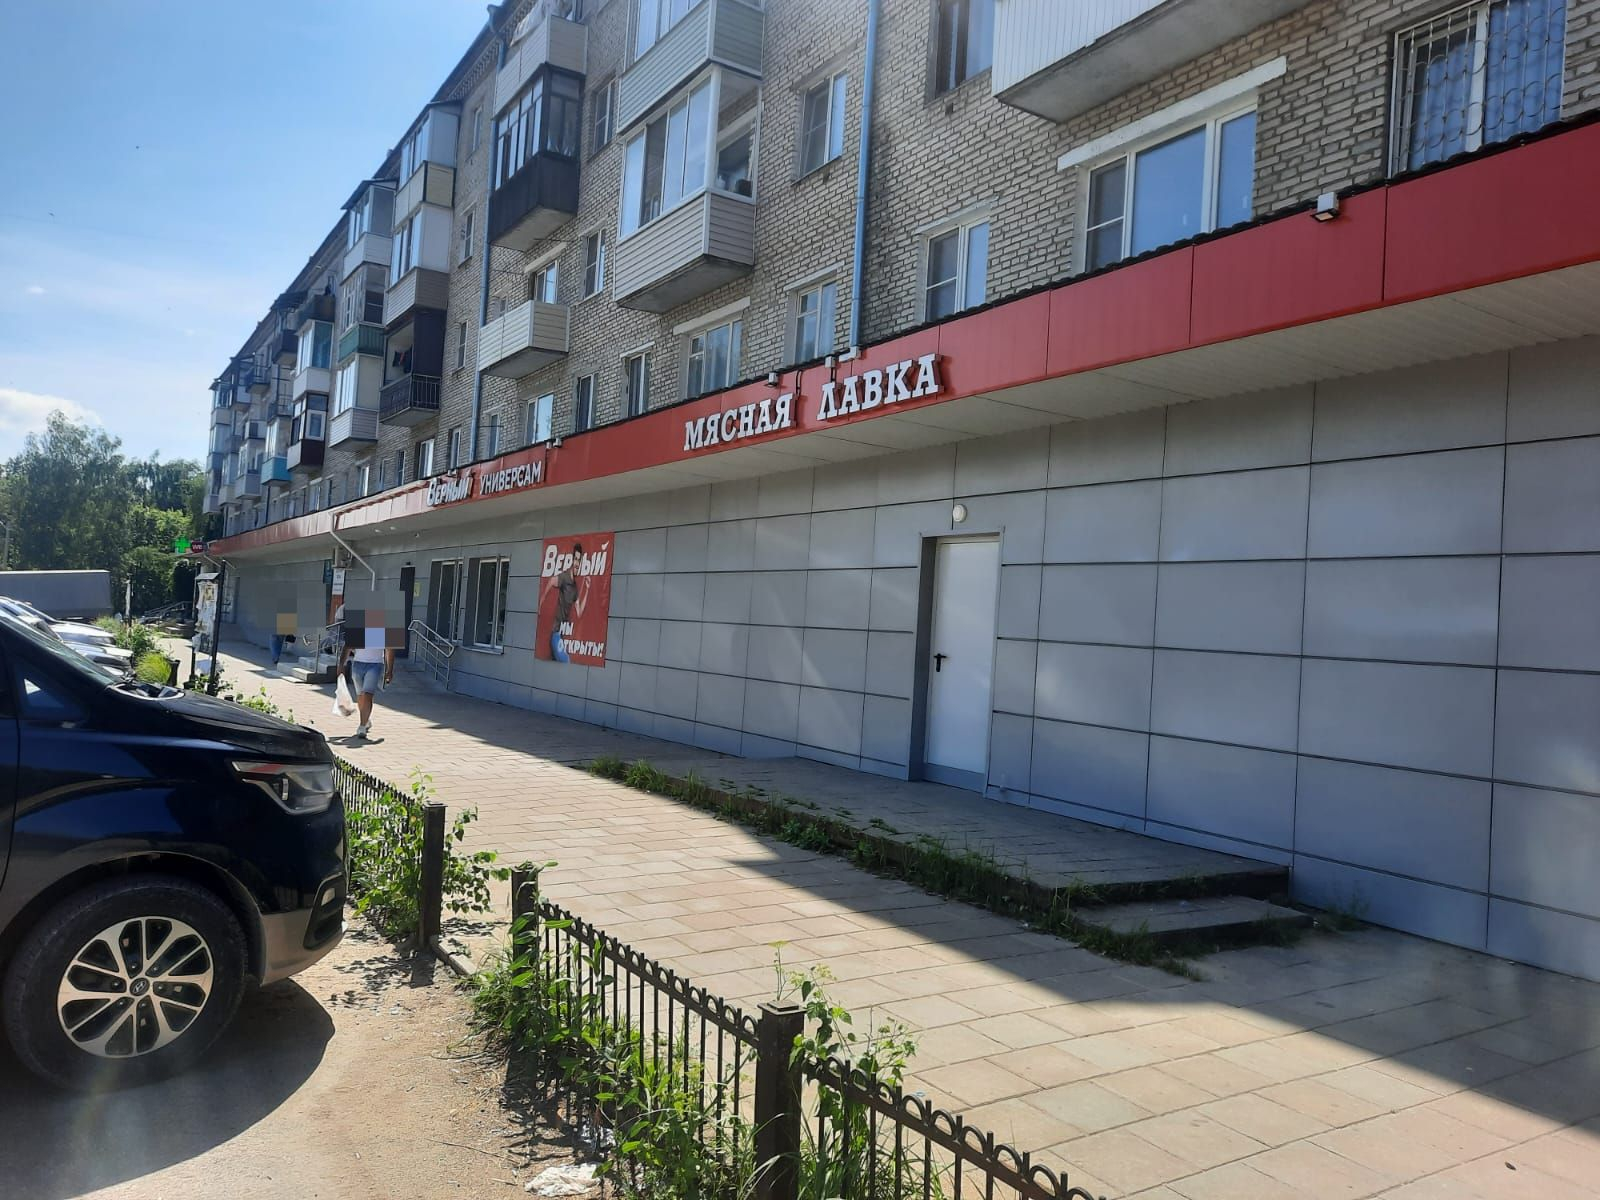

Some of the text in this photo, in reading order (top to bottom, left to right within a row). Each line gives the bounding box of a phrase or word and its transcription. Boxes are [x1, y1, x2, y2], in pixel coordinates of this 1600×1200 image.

[683, 353, 940, 451] МЯСНАЯ ЛАВКА
[479, 460, 542, 495] УНИВЕРСАМ
